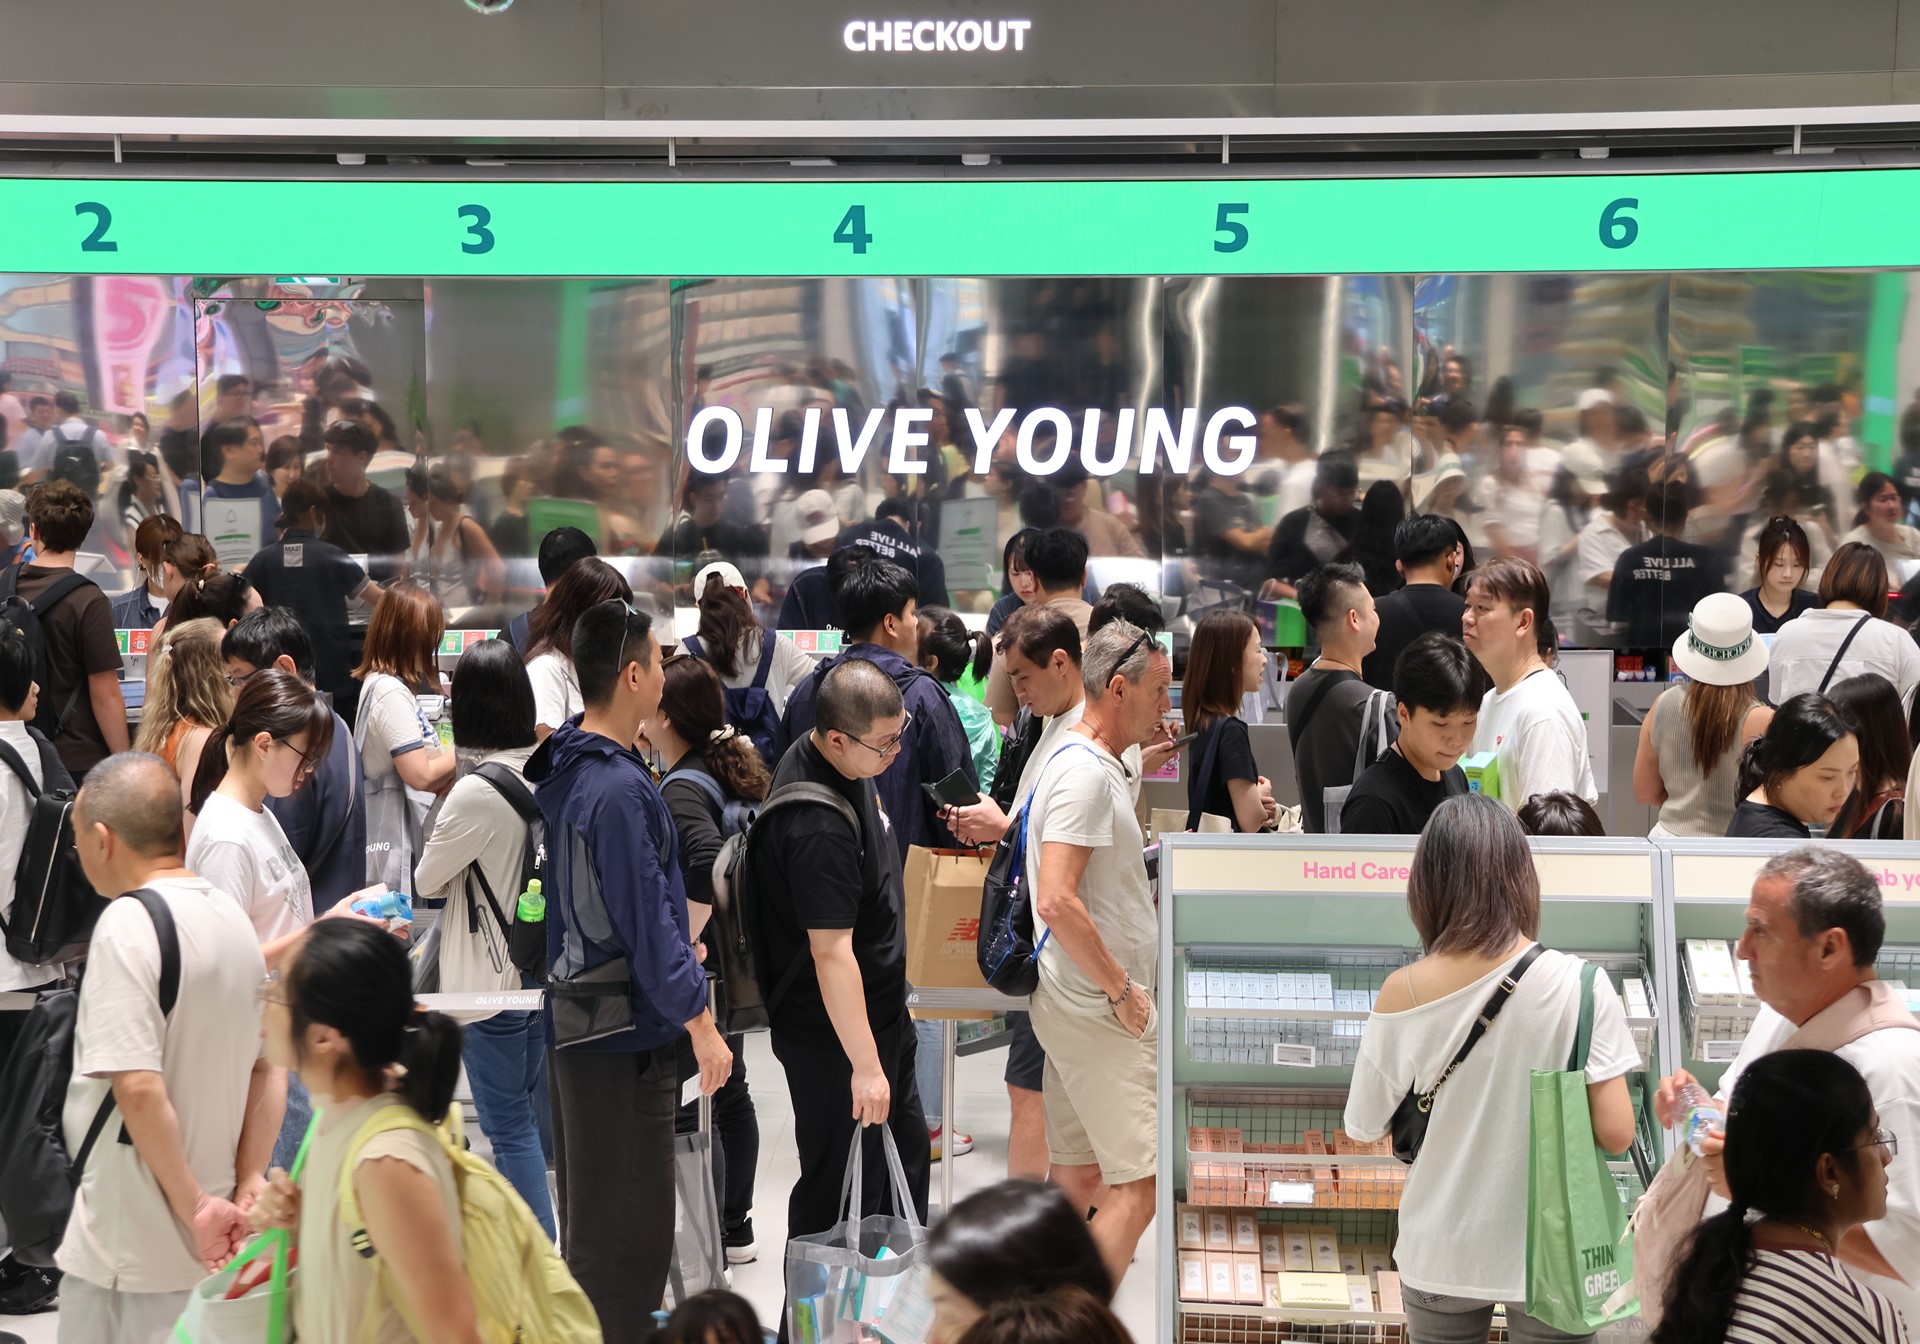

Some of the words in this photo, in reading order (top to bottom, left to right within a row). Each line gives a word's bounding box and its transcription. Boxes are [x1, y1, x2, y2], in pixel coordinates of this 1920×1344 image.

[844, 20, 1032, 51] CHECKOUT
[74, 202, 118, 252] 2
[457, 204, 496, 255] 3
[833, 205, 873, 254] 4
[1213, 203, 1250, 253] 5
[1598, 198, 1640, 250] 6
[686, 406, 934, 475] OLIVE
[964, 406, 1258, 476] YOUNG
[366, 841, 390, 855] OUNG
[1303, 861, 1356, 879] Hand
[1361, 862, 1410, 880] Care
[476, 996, 504, 1005] OLIVE
[504, 995, 539, 1005] YOUNG
[1581, 1244, 1615, 1270] THIN
[1584, 1269, 1620, 1297] GREE
